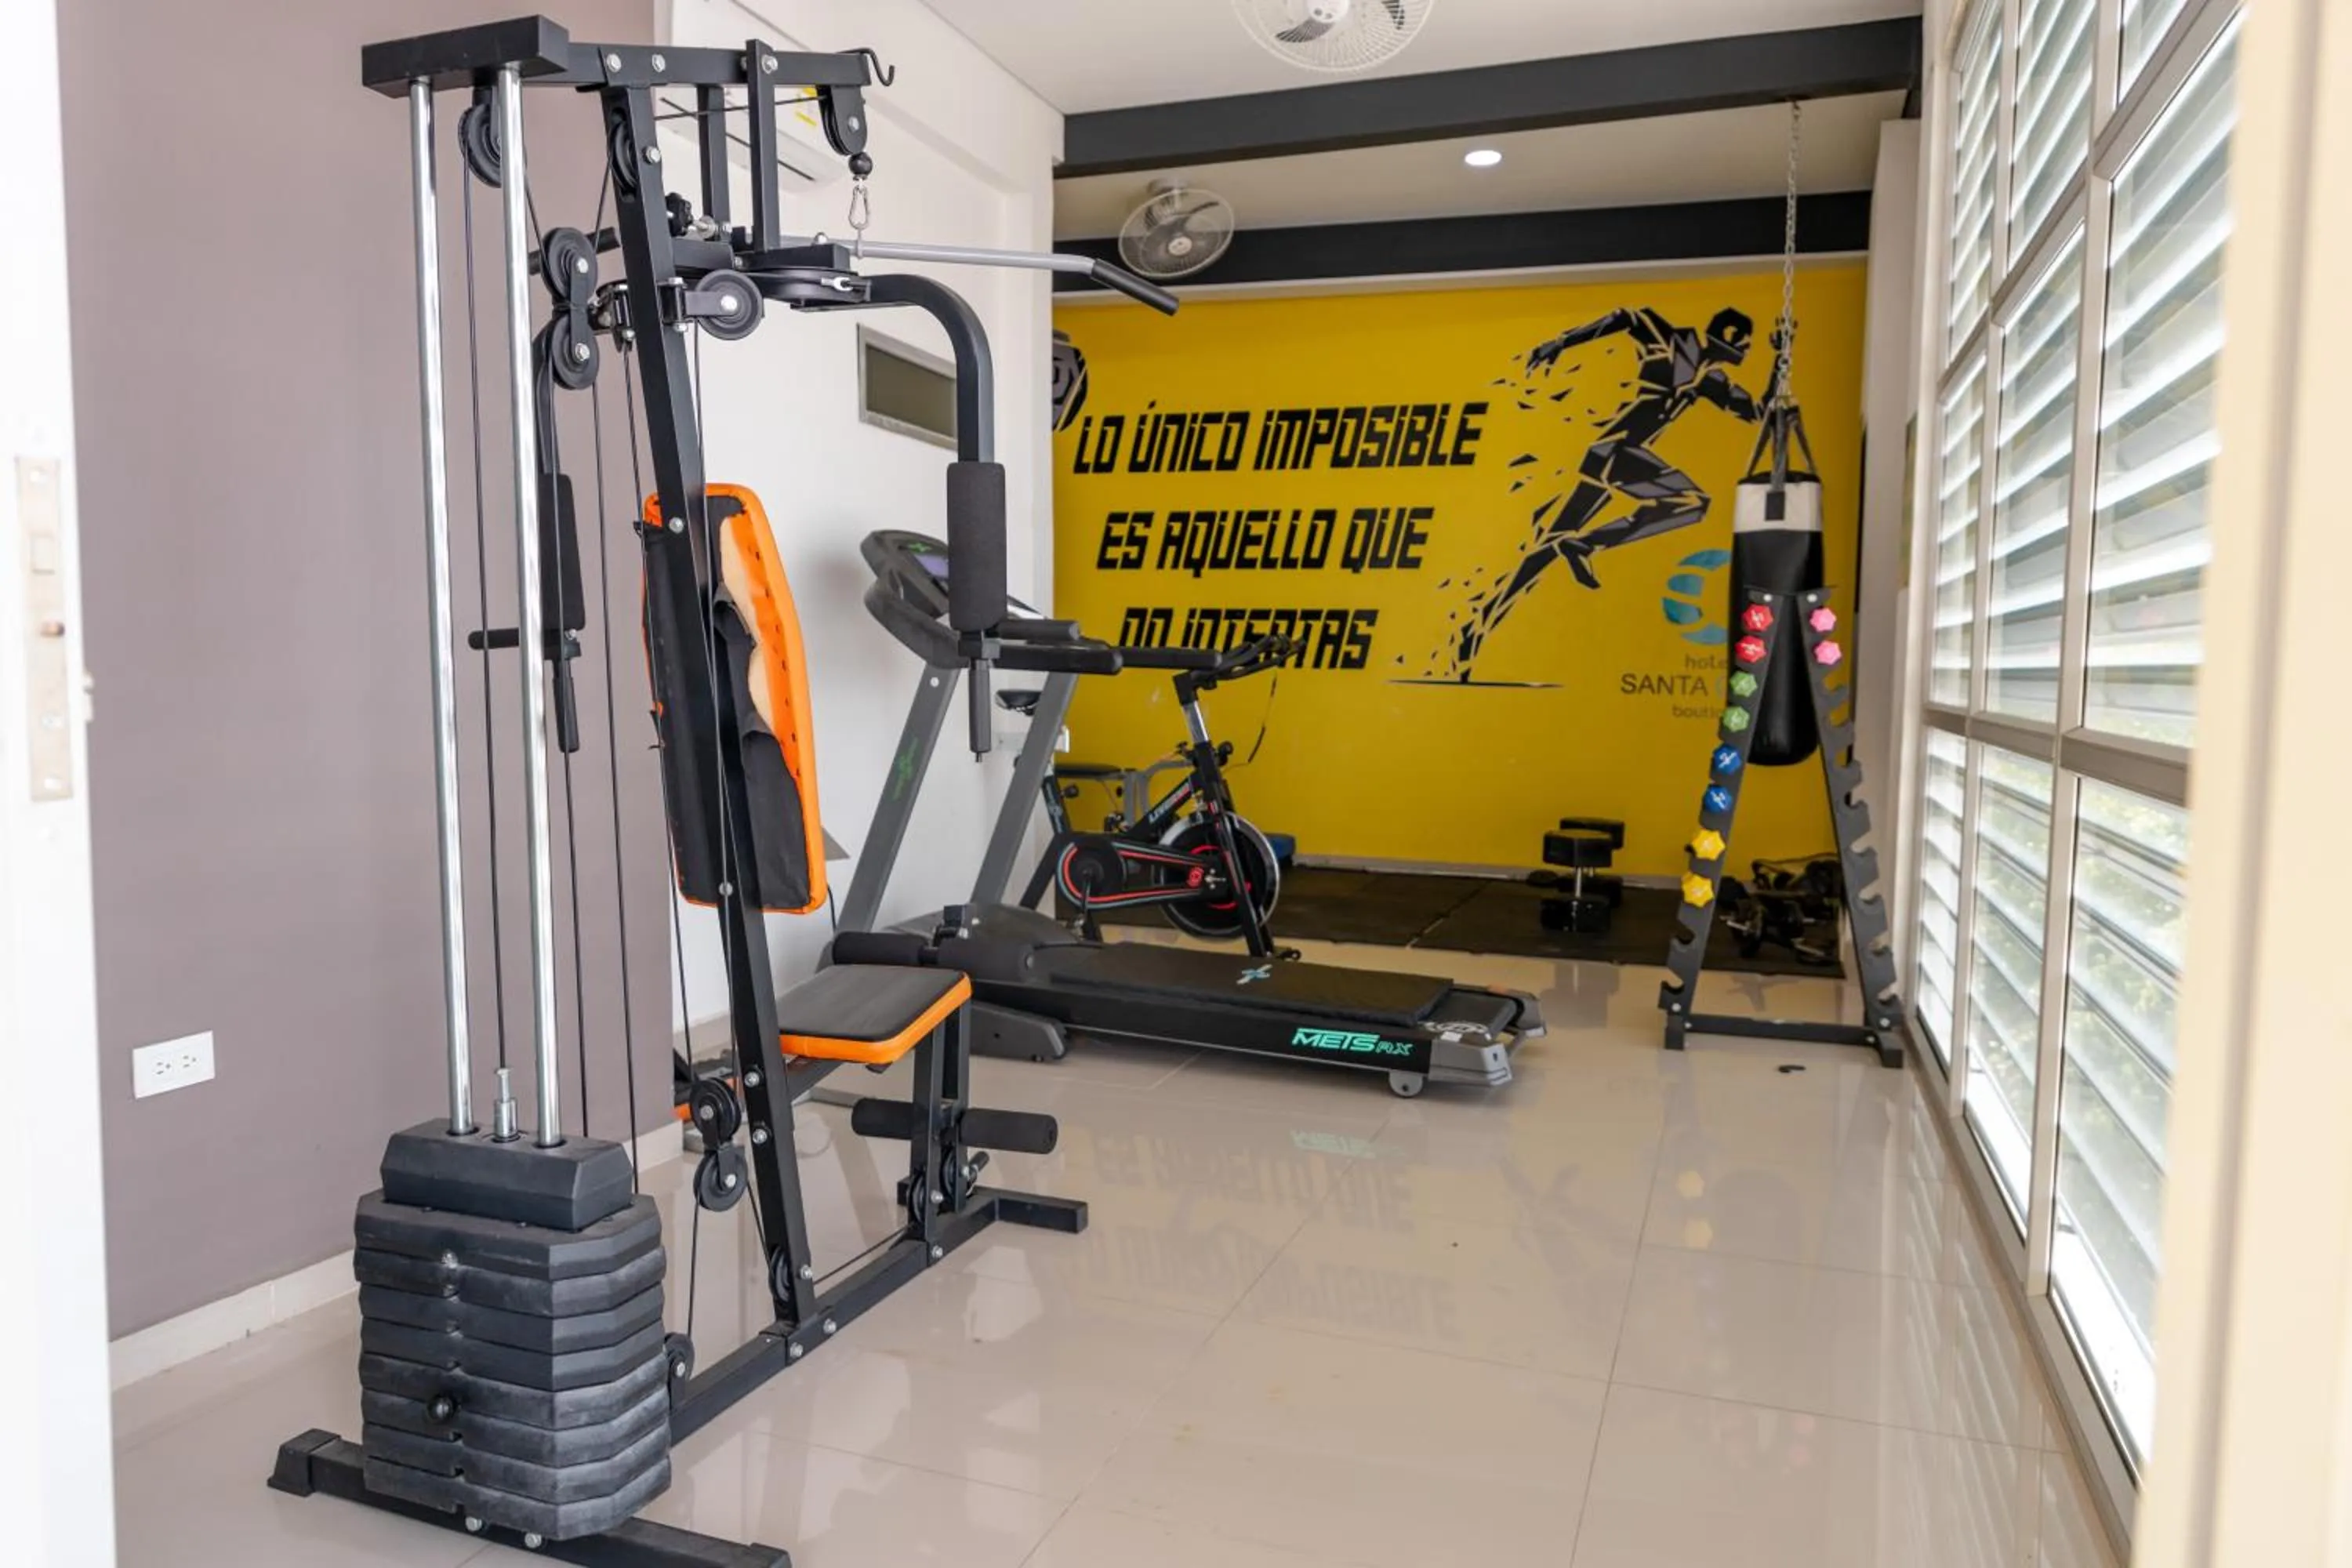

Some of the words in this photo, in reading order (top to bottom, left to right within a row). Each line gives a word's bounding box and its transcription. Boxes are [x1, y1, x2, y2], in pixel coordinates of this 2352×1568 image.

[1073, 416, 1125, 474] LO
[1095, 511, 1155, 570] ES
[1156, 509, 1338, 578] AQUELLO
[1339, 506, 1435, 575] QUE
[1686, 654, 1729, 670] hote
[1620, 672, 1709, 697] SANTA
[1291, 1027, 1381, 1052] METS
